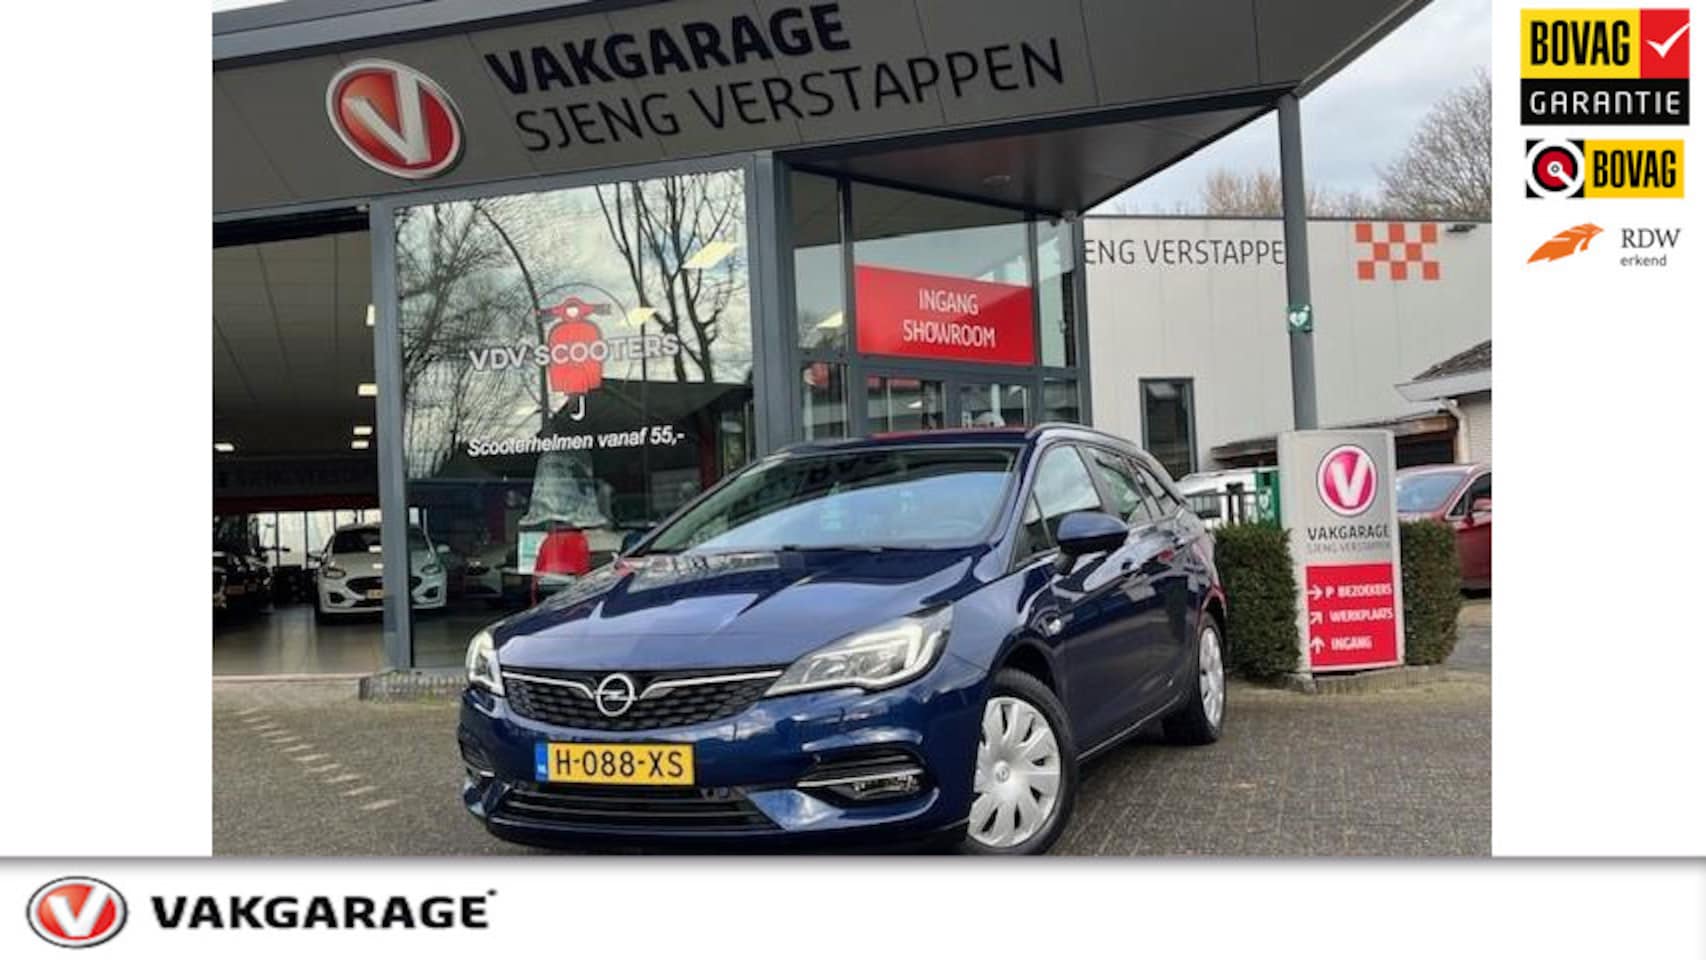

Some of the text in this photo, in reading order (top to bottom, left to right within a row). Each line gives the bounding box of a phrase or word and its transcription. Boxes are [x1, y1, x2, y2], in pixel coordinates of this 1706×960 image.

[485, 2, 851, 95] VAKGARAGE
[515, 37, 1064, 152] SJENG VERSTAPPEN
[918, 287, 979, 316] INGANG
[903, 318, 996, 348] SHOWROOM
[469, 333, 680, 371] VDV SCOOTERS
[467, 424, 686, 458] Scooterhelmen vanaf 55,-
[1307, 524, 1391, 541] VAKGARAGE
[556, 749, 684, 778] H-088-XS
